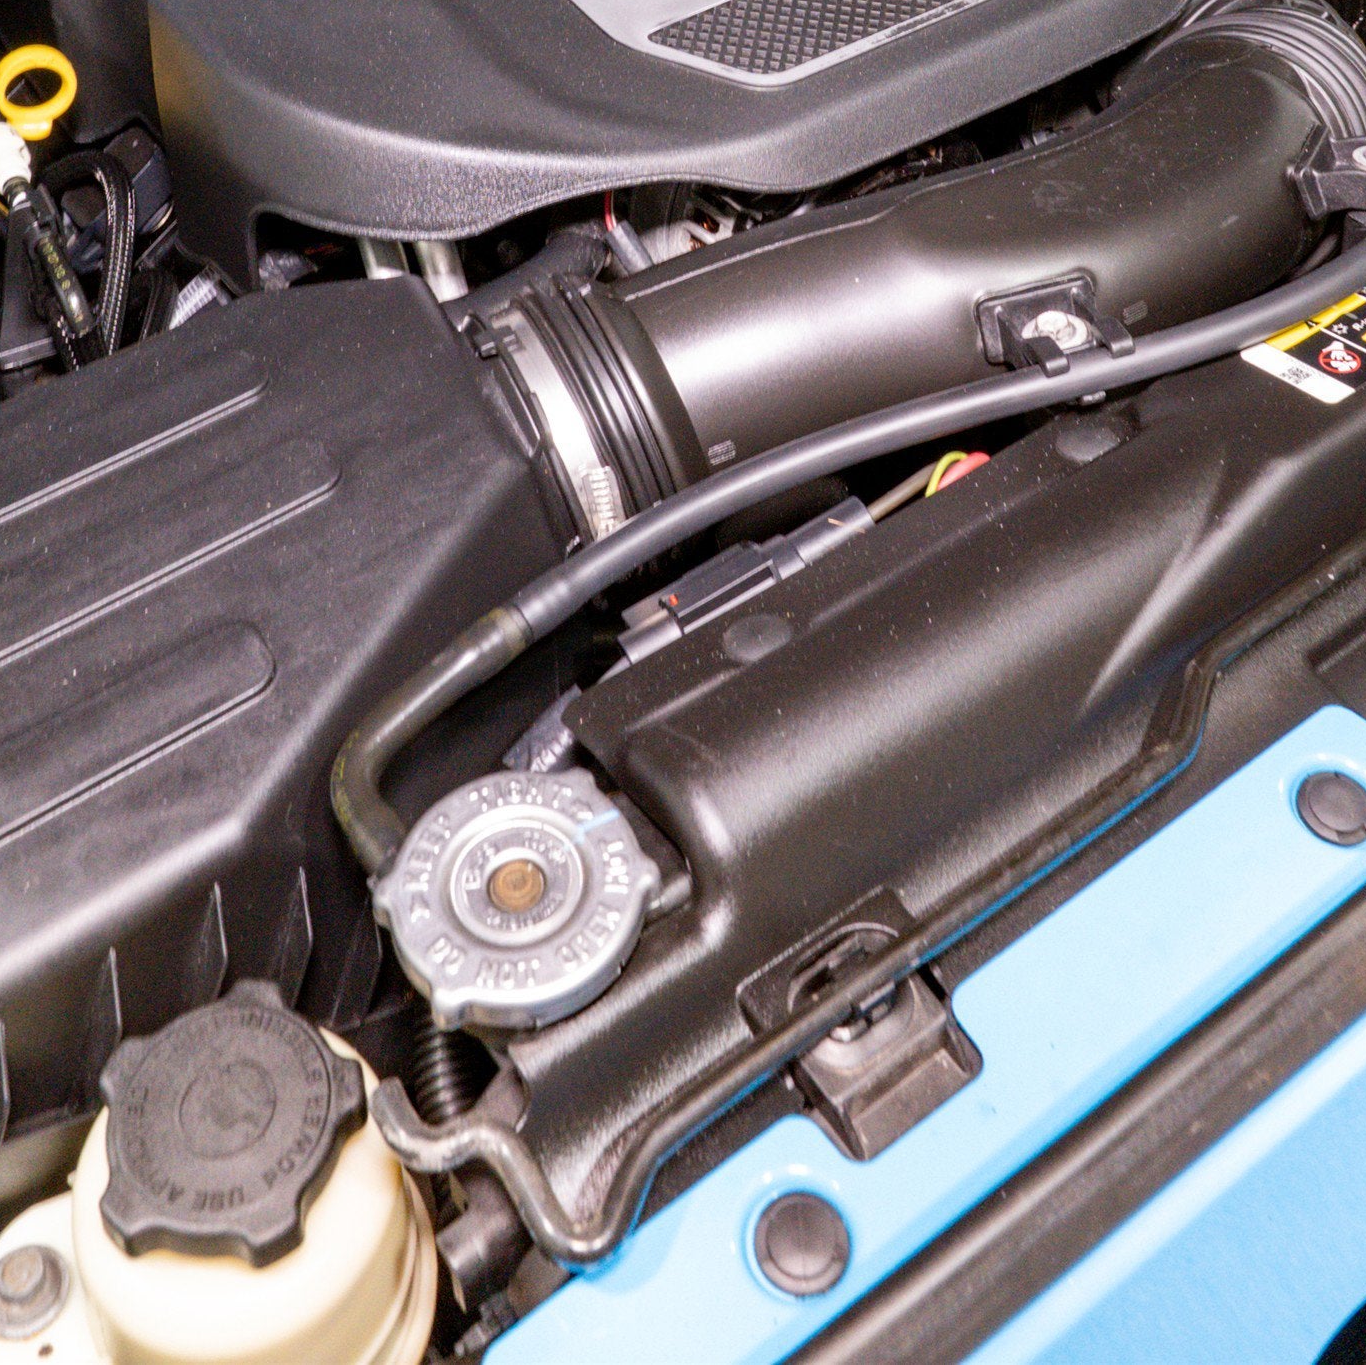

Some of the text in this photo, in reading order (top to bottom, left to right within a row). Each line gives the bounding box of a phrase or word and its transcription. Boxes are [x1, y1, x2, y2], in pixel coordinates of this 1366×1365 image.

[404, 815, 451, 892] KEEP
[469, 780, 573, 812] TIGHT
[428, 936, 465, 976] DO
[475, 957, 541, 989] NOT
[557, 903, 621, 972] OPEN
[262, 1096, 321, 1188] POWER
